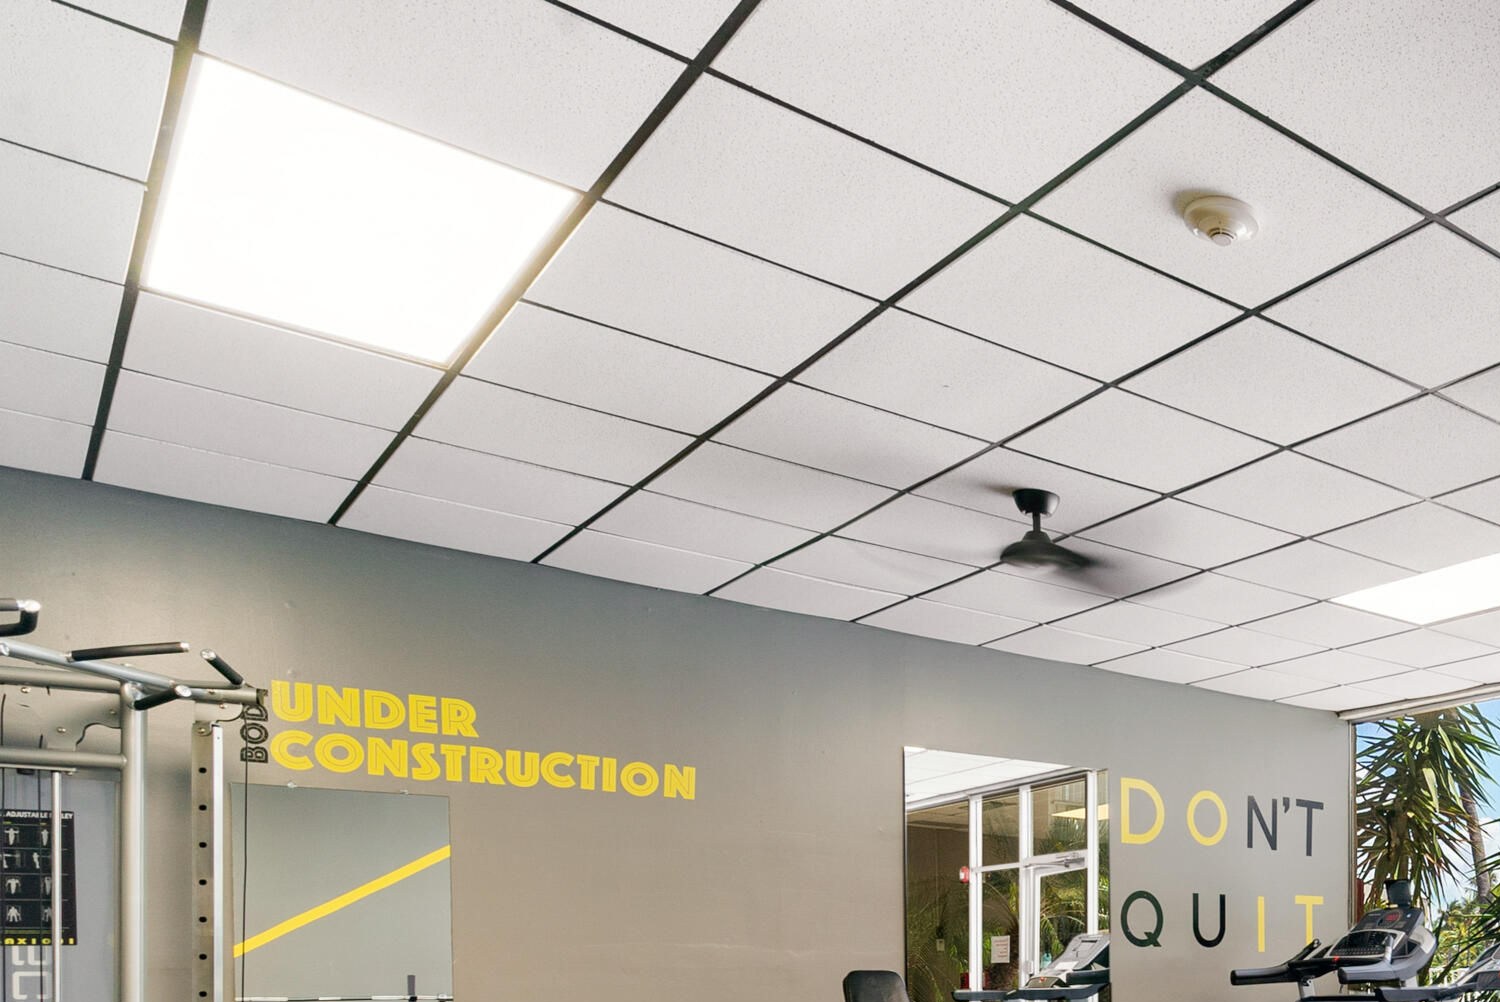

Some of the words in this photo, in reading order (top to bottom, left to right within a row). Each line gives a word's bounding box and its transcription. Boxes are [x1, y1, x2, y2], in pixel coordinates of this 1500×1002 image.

[239, 687, 268, 763] BOD
[271, 680, 479, 738] UNDER
[269, 729, 696, 800] CONSTRUCTION
[1120, 777, 1324, 857] DON'T
[1120, 890, 1324, 953] QUIT
